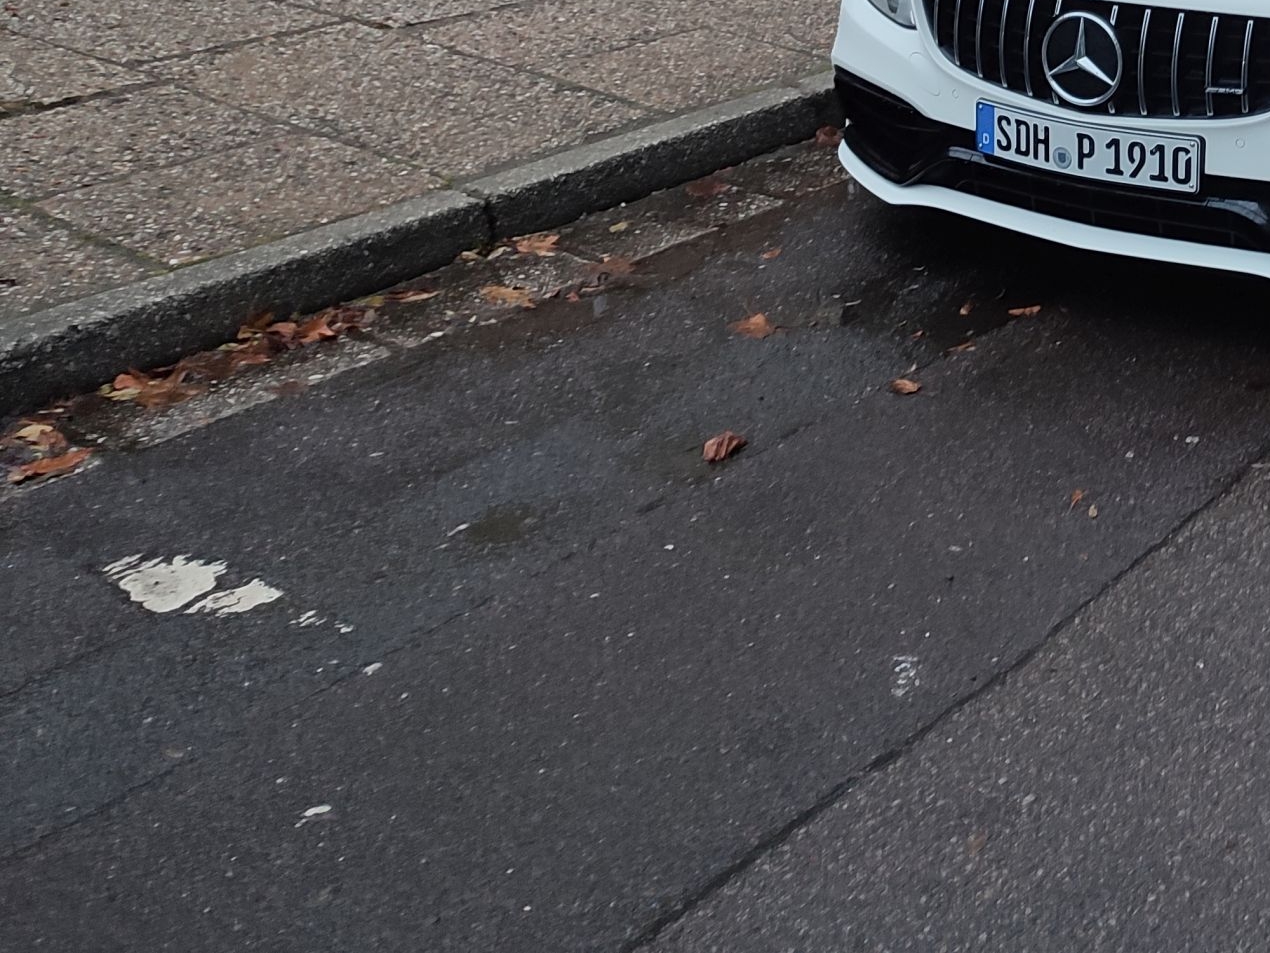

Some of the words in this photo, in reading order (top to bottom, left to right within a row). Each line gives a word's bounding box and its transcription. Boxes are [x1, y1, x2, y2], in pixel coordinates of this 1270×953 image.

[982, 133, 990, 145] D
[996, 114, 1051, 163] SDH
[1076, 132, 1096, 170] P
[1105, 138, 1192, 185] 1910
